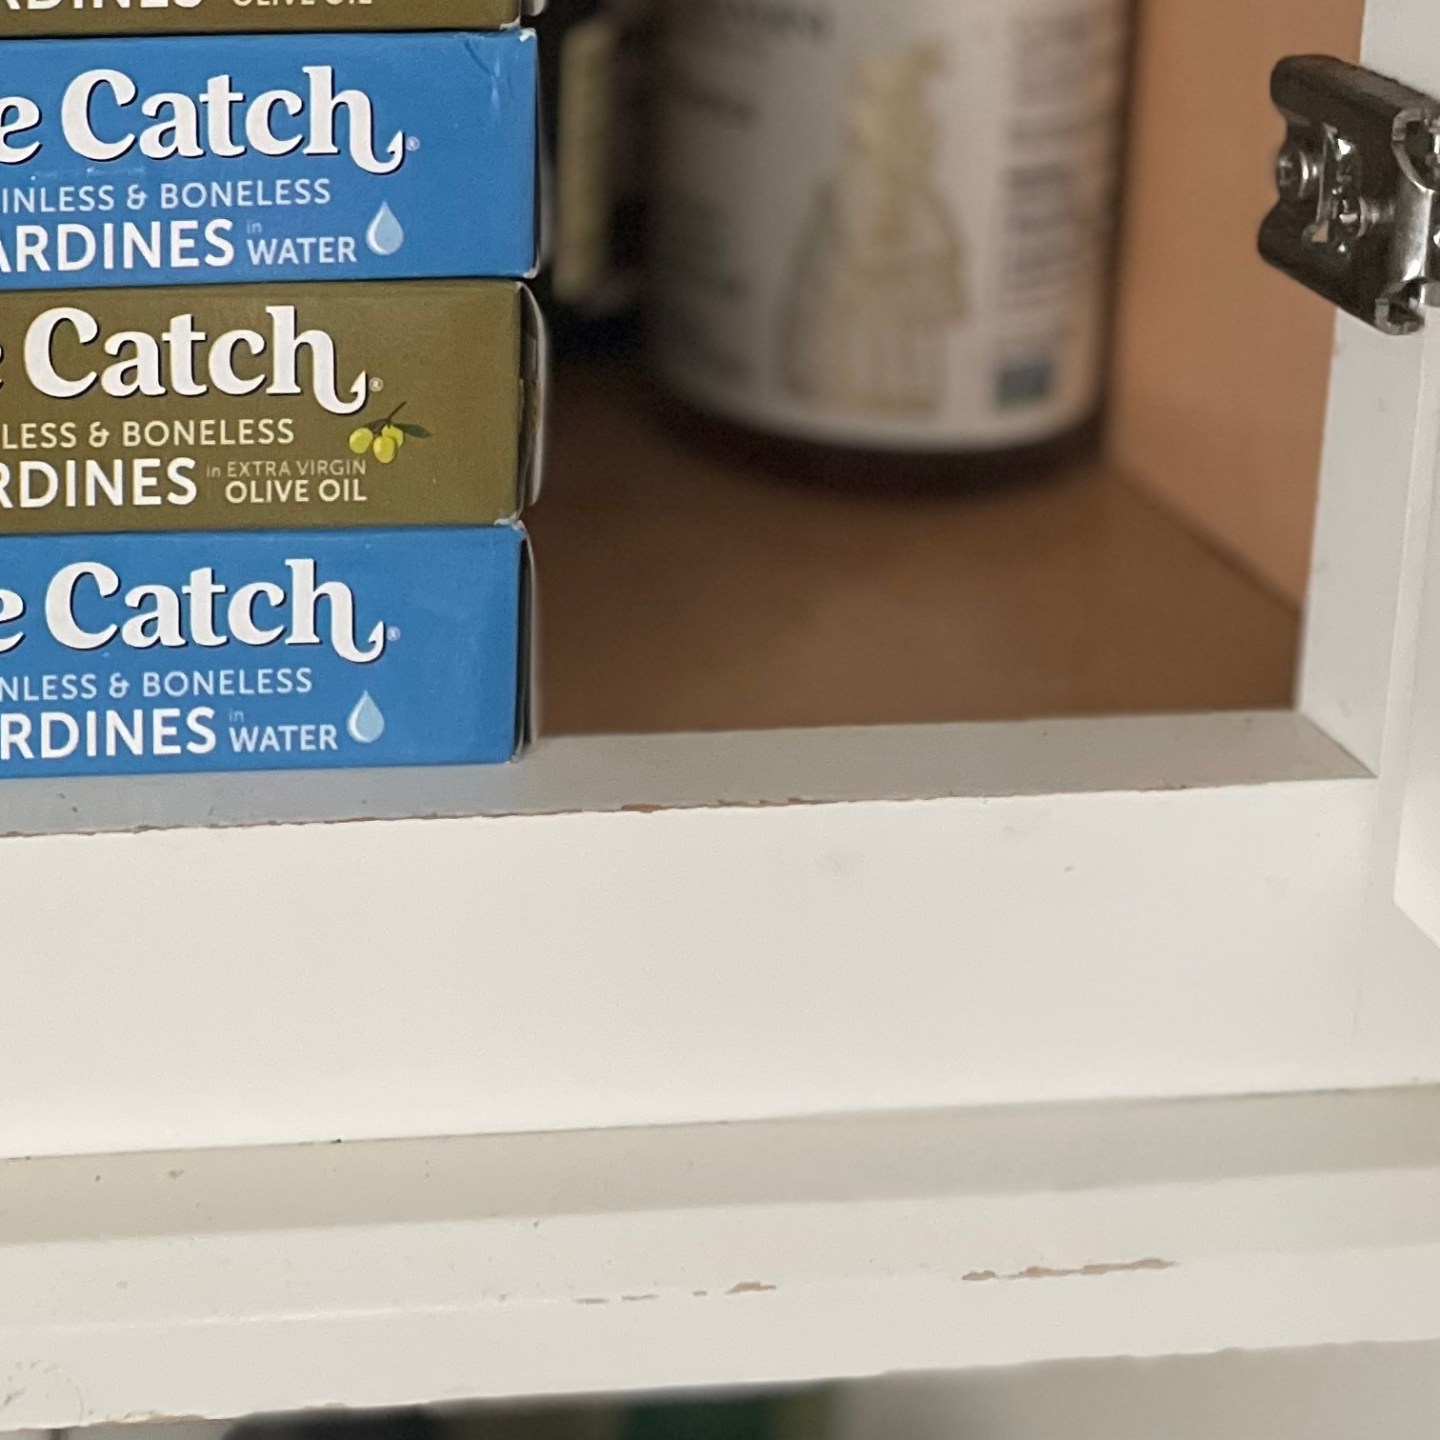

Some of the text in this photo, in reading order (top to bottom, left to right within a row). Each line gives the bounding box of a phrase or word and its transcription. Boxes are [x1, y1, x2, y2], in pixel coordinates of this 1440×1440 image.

[60, 65, 403, 174] Catch
[126, 183, 148, 210] &
[160, 178, 331, 209] BONELESS
[246, 221, 263, 235] in
[246, 236, 357, 266] WATER
[23, 305, 366, 414] Catch
[88, 421, 110, 448] &
[122, 418, 294, 447] BONELESS
[206, 465, 222, 478] in
[227, 460, 290, 478] EXTRA
[295, 459, 366, 476] VIRGIN
[225, 478, 368, 504] OLIVE OIL
[44, 558, 384, 663] Catch
[108, 672, 130, 699] &
[143, 667, 313, 698] BONELESS
[228, 709, 245, 723] in
[229, 724, 338, 753] WATER
